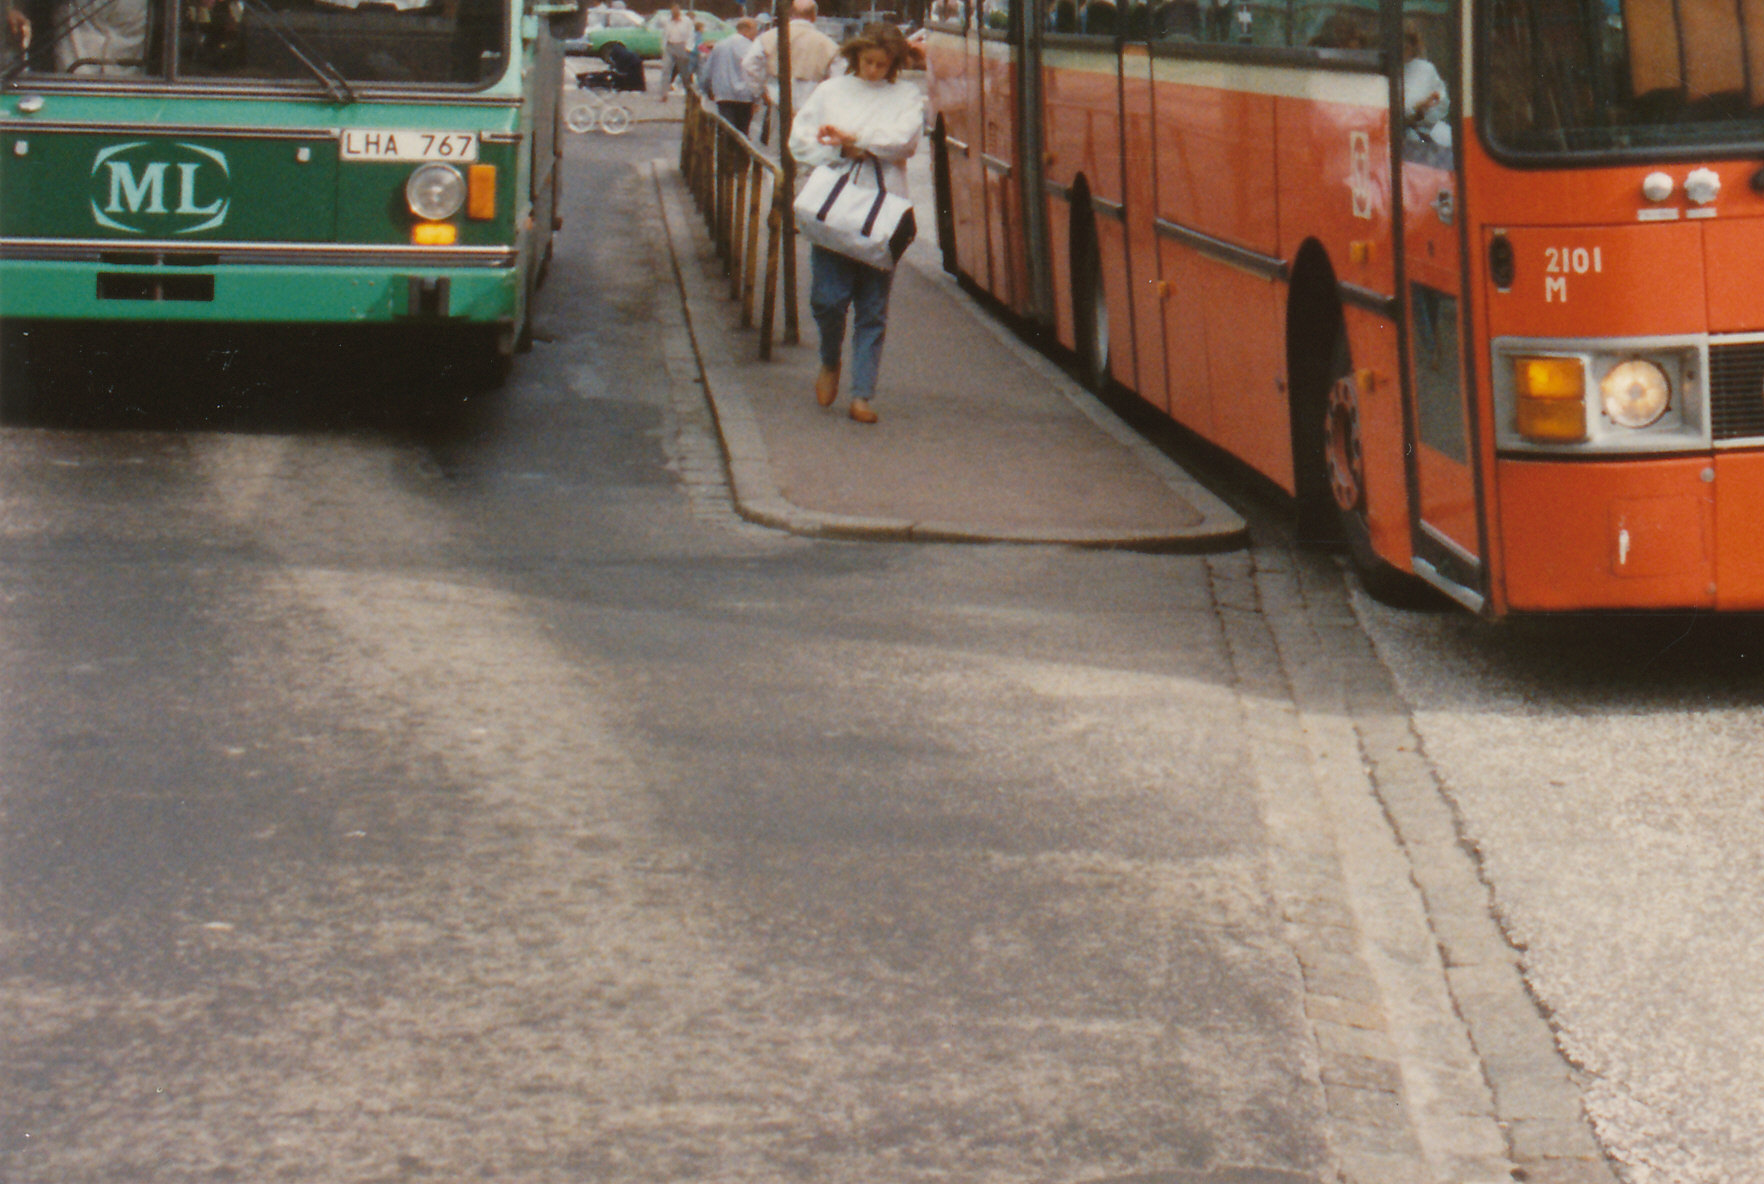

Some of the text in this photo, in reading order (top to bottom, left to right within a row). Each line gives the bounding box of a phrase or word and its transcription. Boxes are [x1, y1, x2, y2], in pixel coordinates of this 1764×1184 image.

[346, 132, 472, 156] LHA 767
[105, 161, 224, 214] ML
[1545, 246, 1602, 273] 2101
[1545, 276, 1567, 303] M
